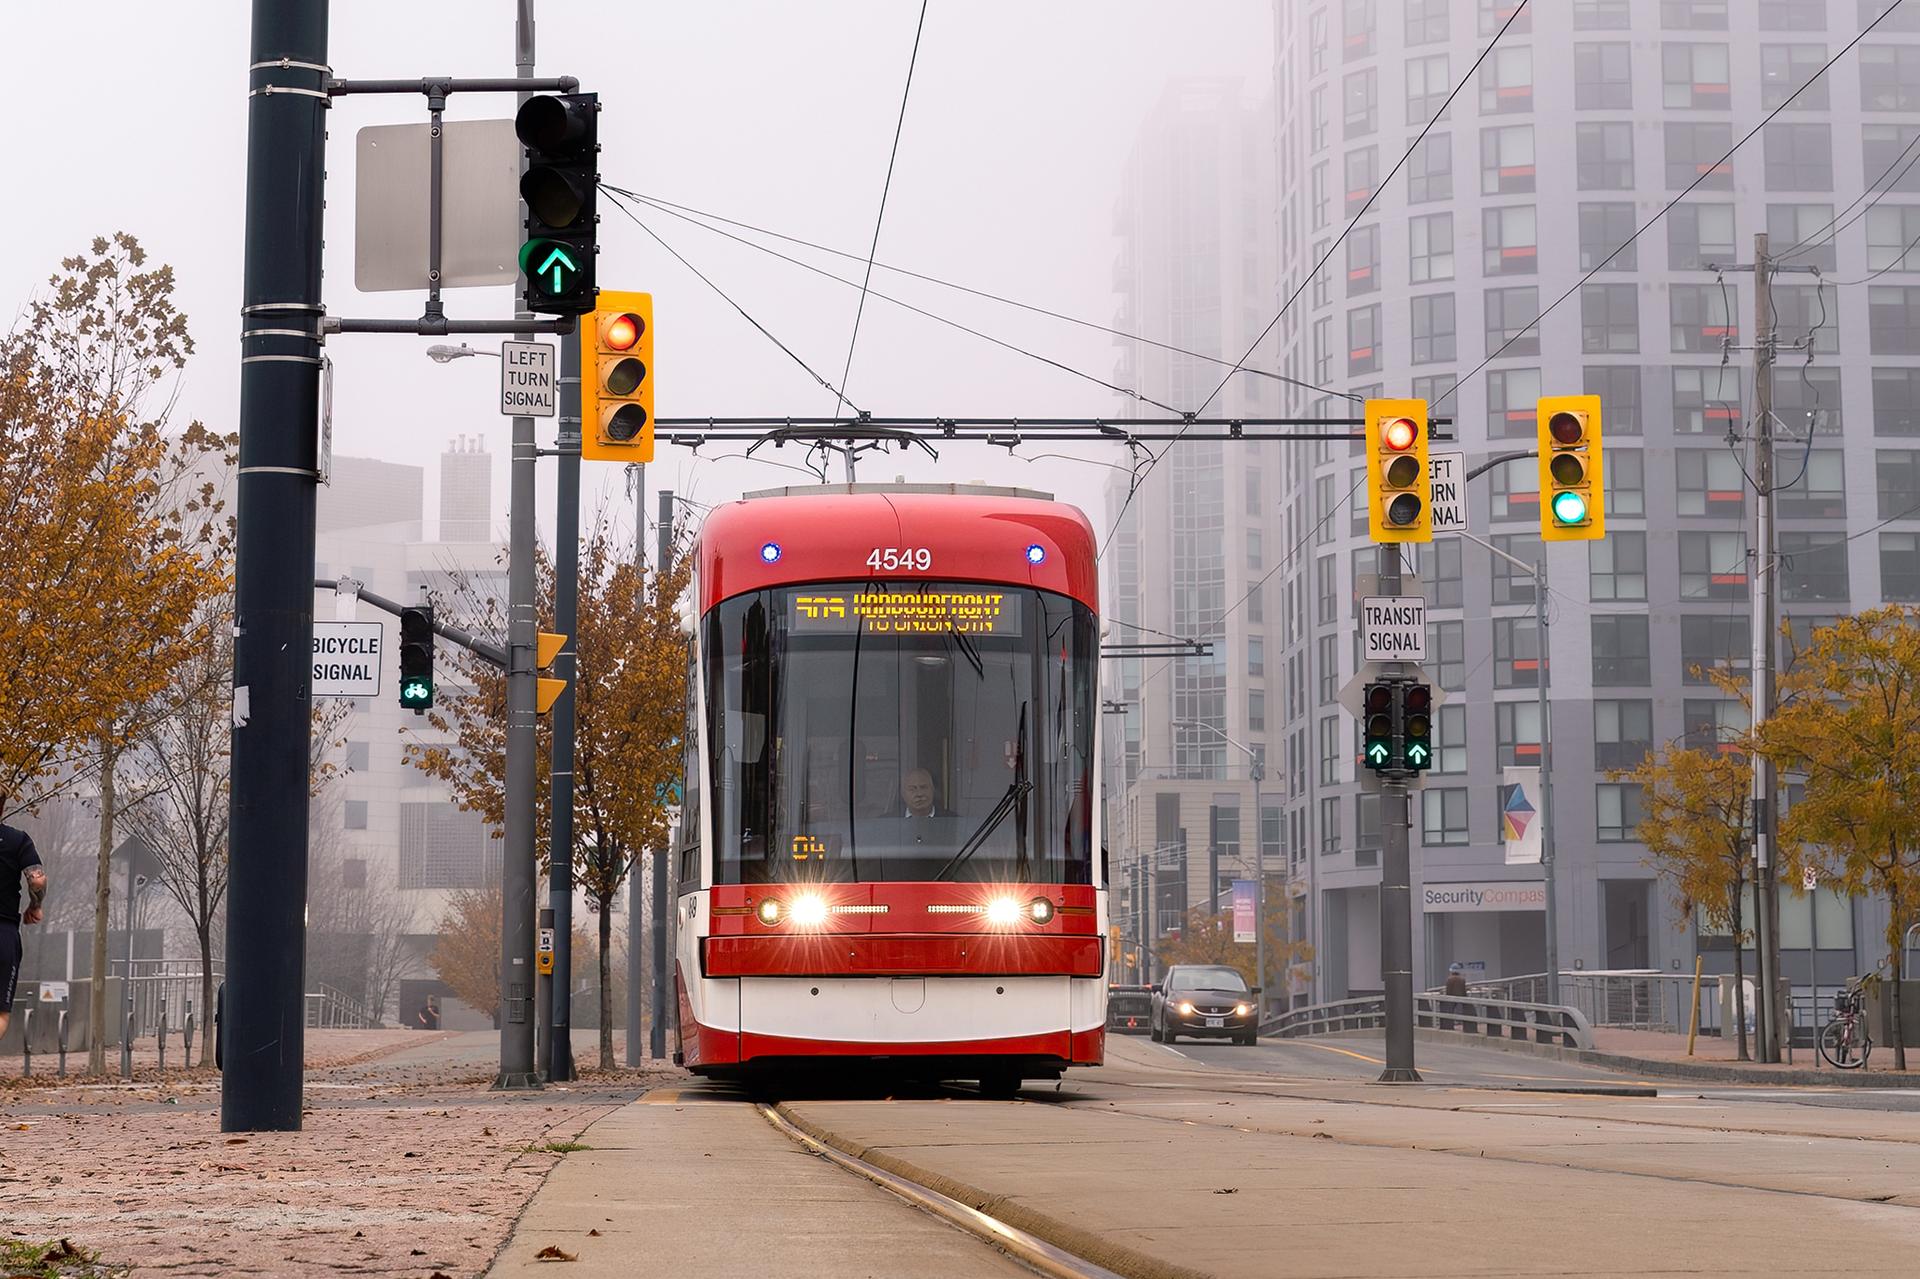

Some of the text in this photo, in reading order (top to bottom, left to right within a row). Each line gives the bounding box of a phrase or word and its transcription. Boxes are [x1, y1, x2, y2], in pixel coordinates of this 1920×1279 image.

[509, 350, 547, 367] LEFT
[508, 371, 549, 387] TURN
[504, 391, 552, 408] SIGNAL
[1428, 459, 1452, 479] EFT
[1430, 483, 1456, 502] RN
[1431, 505, 1464, 526] NAL
[866, 548, 932, 571] 4549
[1365, 607, 1423, 625] TRANSIT
[312, 637, 378, 654] BICYCLE
[1370, 632, 1421, 651] SIGNAL
[313, 664, 373, 681] SIGNAL
[793, 835, 825, 861] 04
[1425, 888, 1545, 906] SecurityCompas
